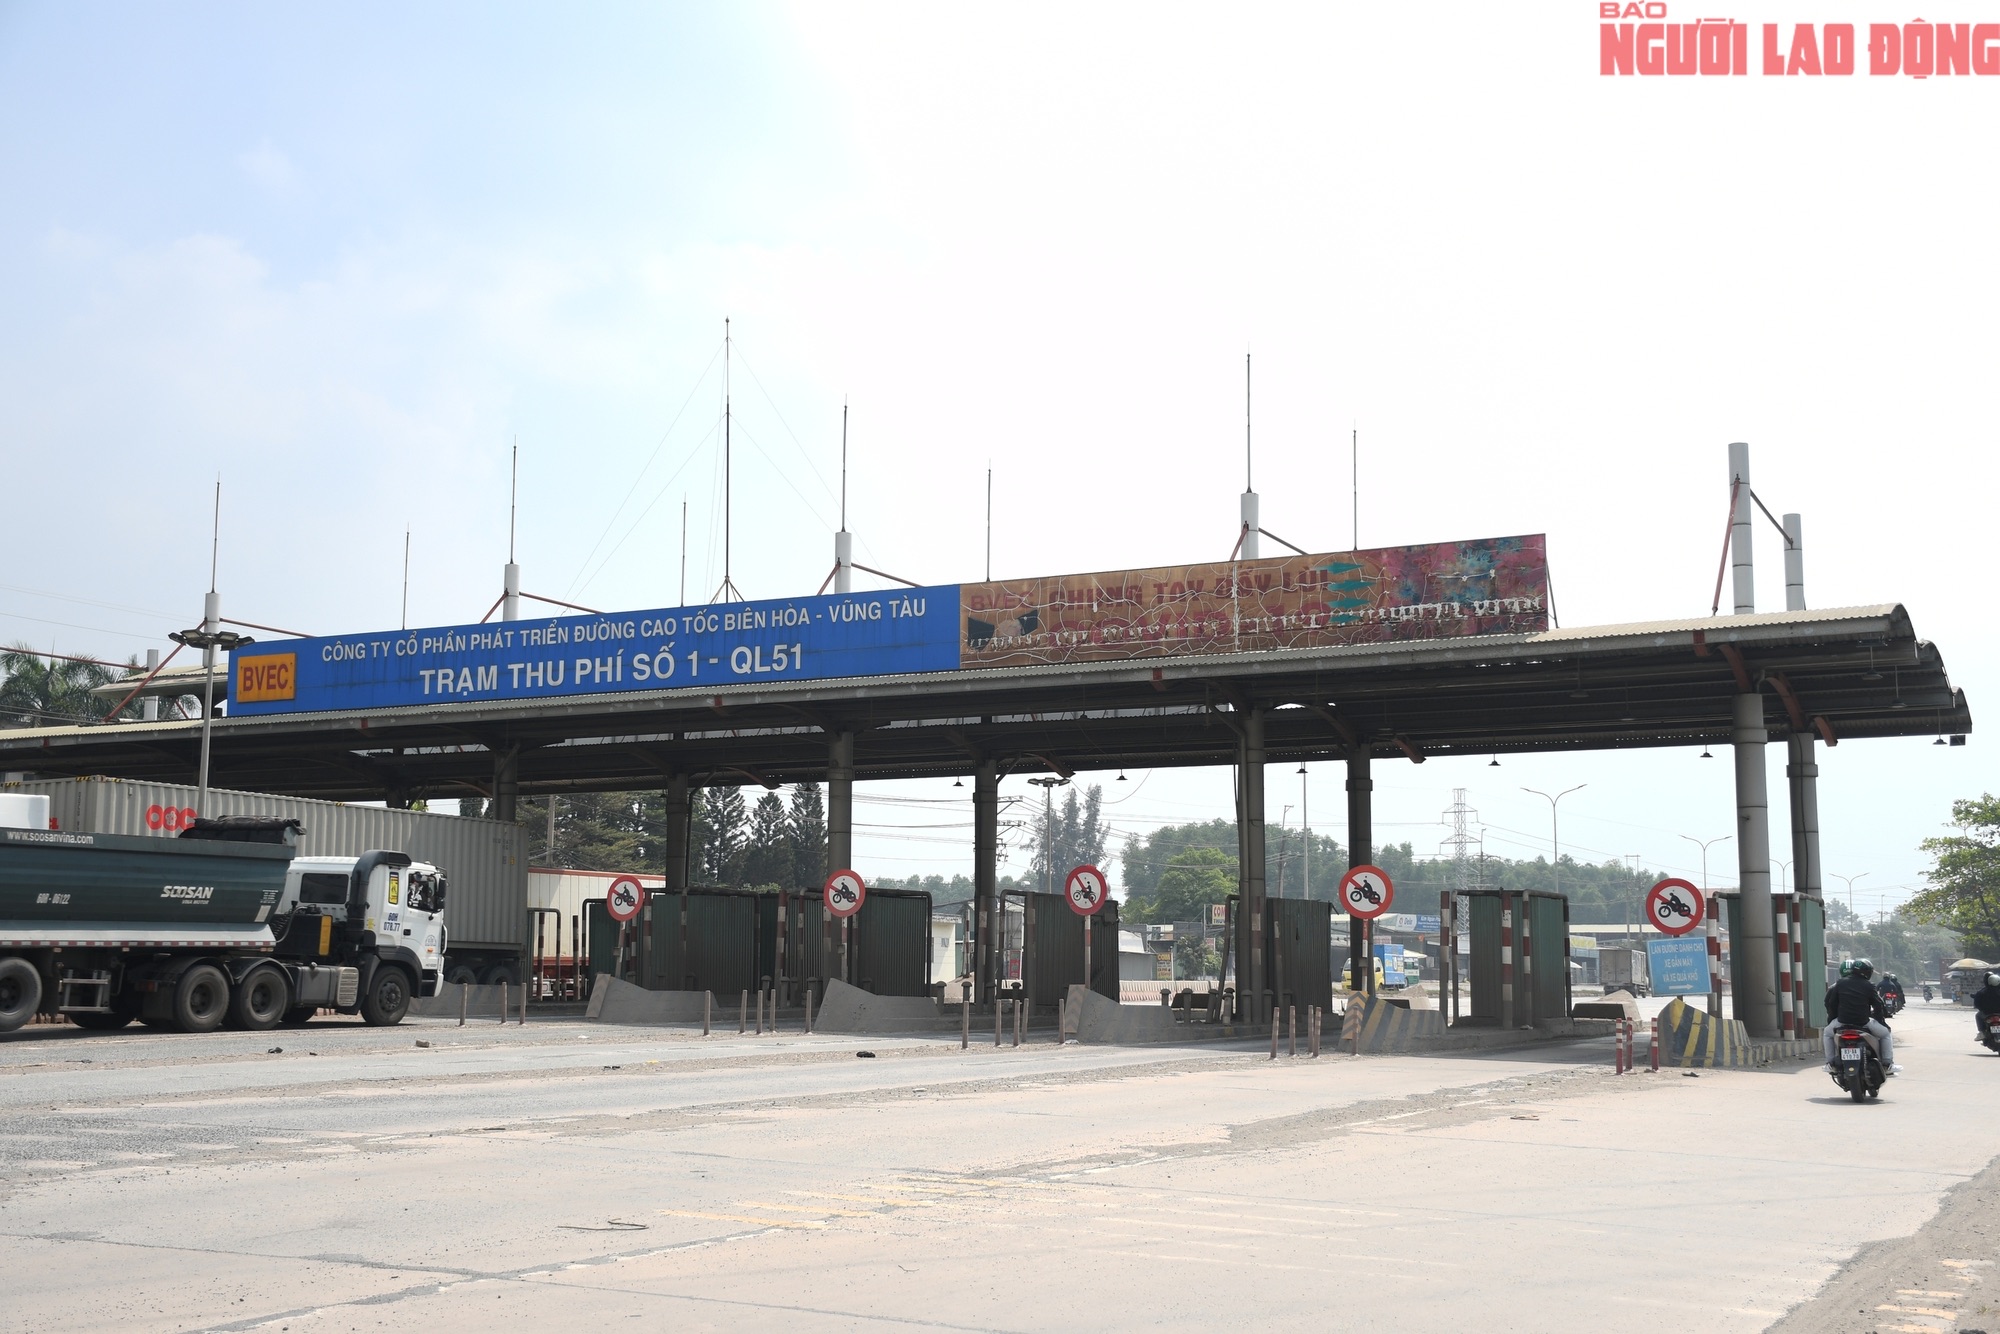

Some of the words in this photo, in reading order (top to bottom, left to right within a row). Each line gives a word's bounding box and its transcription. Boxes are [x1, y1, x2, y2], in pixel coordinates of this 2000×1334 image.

[1050, 585, 1143, 612] CHUNG
[1153, 579, 1205, 604] TAY
[1283, 565, 1329, 594] LÙI
[322, 640, 366, 662] CÔNG
[371, 641, 391, 658] TY
[395, 630, 418, 656] CỔ
[422, 630, 466, 654] PHẦN
[470, 628, 514, 650] PHÁT
[520, 619, 569, 647] TRIỂN
[573, 618, 635, 643] ĐƯỜNG
[640, 617, 677, 638] CAO
[682, 608, 719, 635] TỐC
[724, 607, 766, 631] BIÊN
[771, 603, 810, 628] HÒA
[829, 599, 881, 623] VŨNG
[889, 595, 926, 619] TÀU
[242, 663, 289, 692] BVEC
[419, 664, 498, 696] TRẠM
[507, 660, 565, 689] THU
[575, 648, 624, 685] PHÍ
[632, 641, 676, 681] SỐ
[687, 650, 699, 677] 1
[730, 643, 802, 675] QL51
[145, 804, 198, 831] OOC
[6, 831, 94, 844] www.soosanvina.com
[160, 885, 214, 899] SOOSAN
[1693, 943, 1703, 952] CHO
